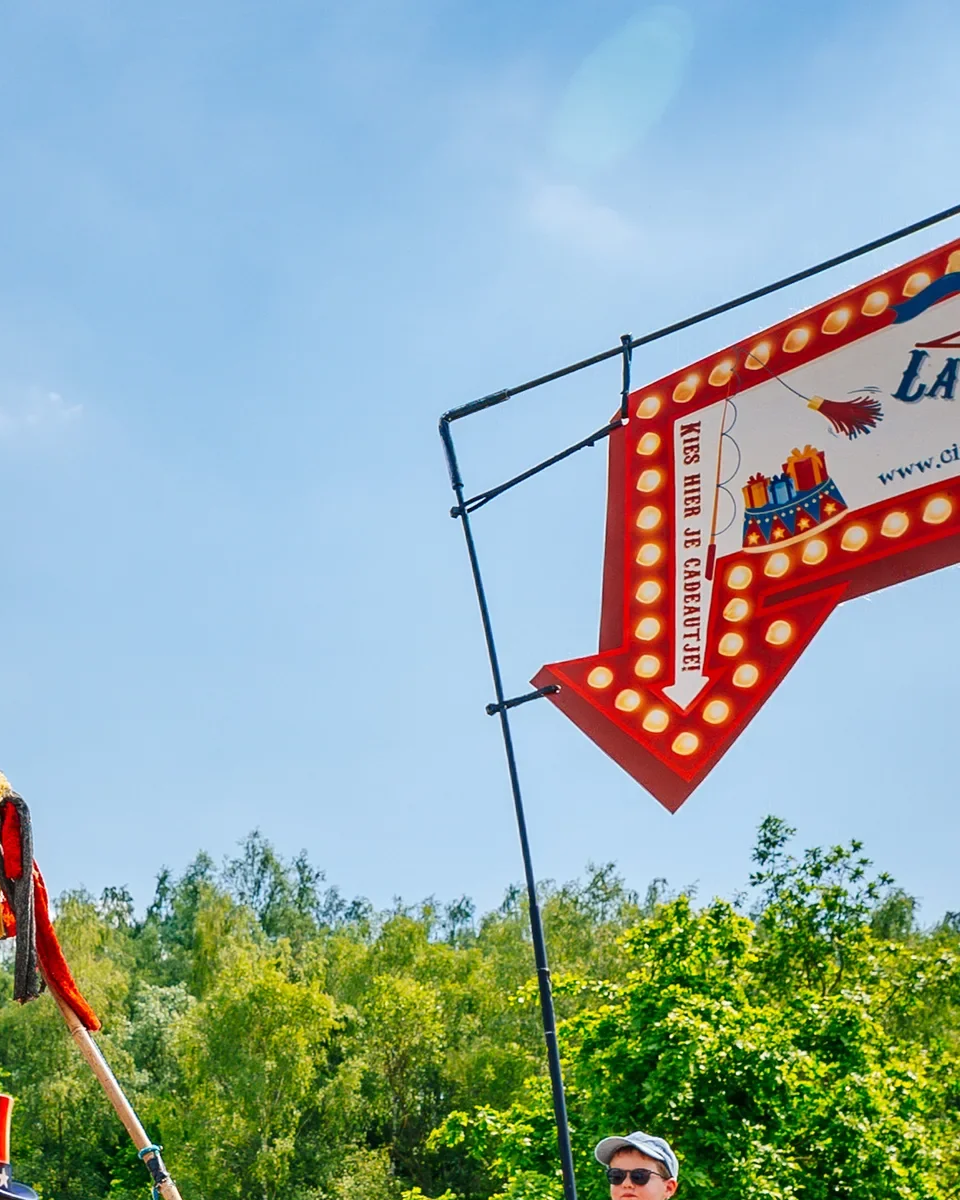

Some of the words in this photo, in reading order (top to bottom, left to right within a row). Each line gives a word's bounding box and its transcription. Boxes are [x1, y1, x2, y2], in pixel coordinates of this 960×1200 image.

[680, 421, 701, 465] KIES
[684, 473, 701, 518] HIER
[684, 527, 701, 549] JE
[681, 557, 701, 672] CADEAUTJE!
